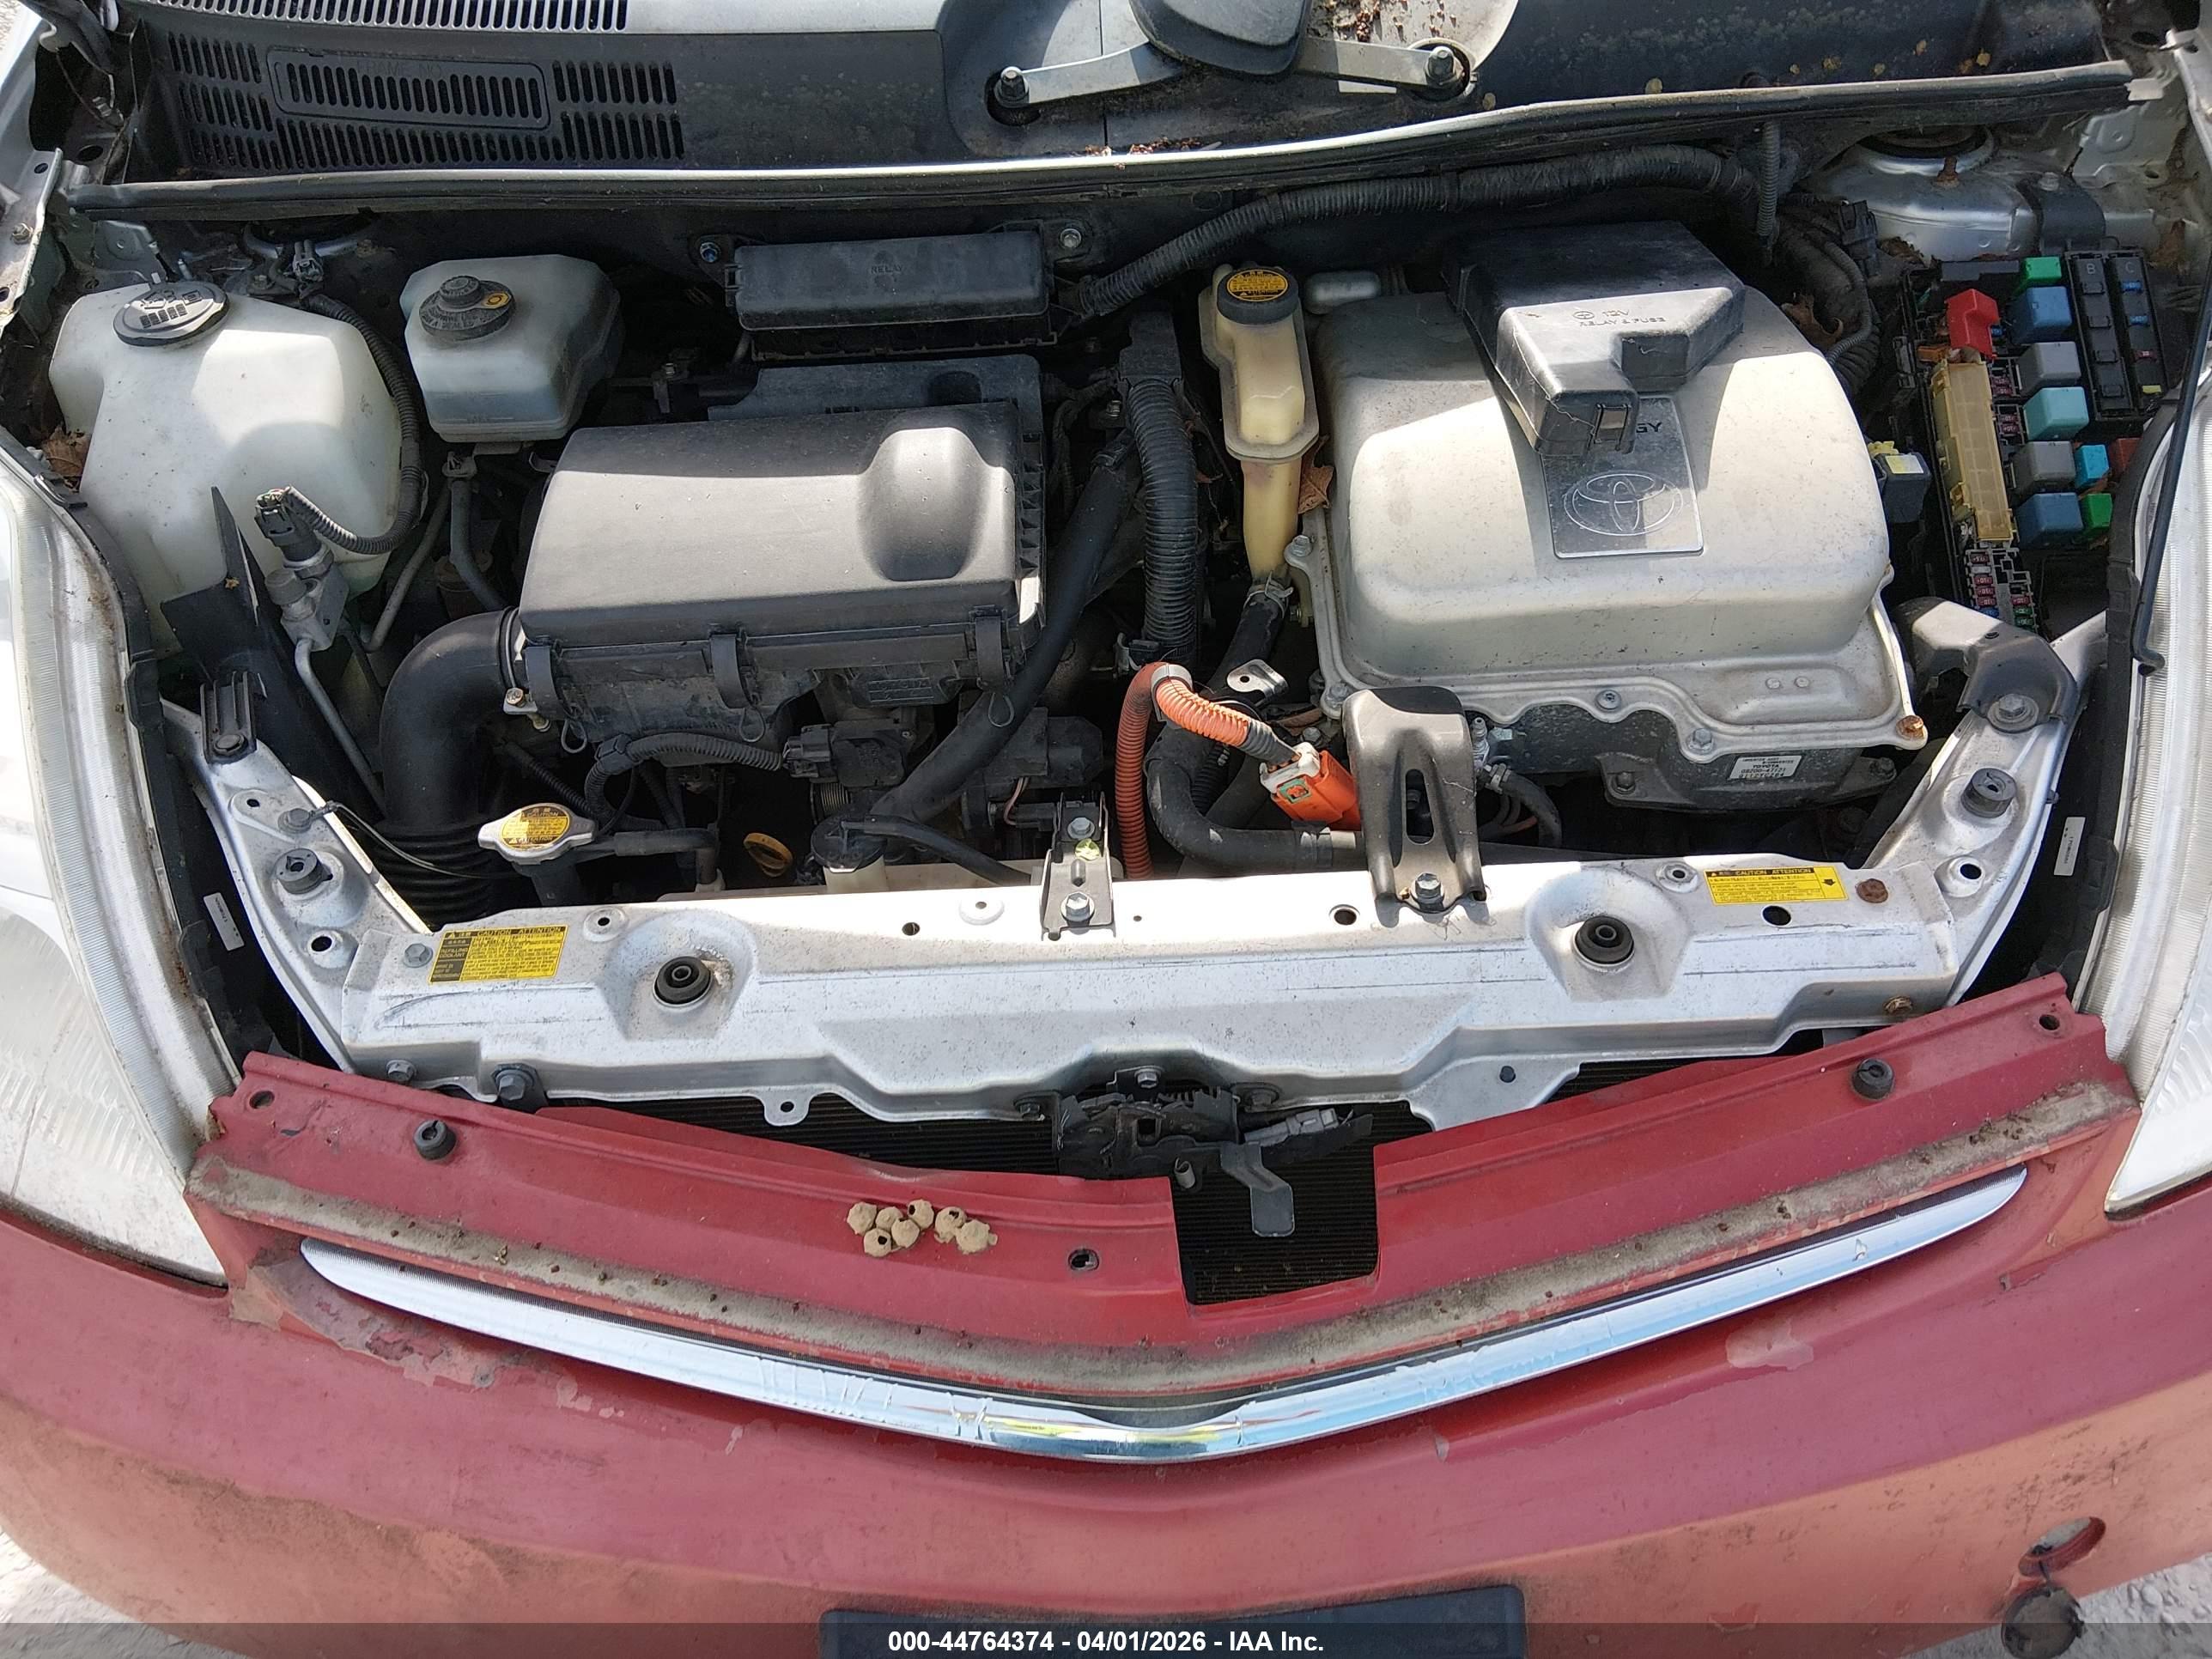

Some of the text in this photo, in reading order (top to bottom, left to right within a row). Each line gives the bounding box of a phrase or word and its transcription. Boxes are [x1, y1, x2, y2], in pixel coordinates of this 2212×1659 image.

[870, 263, 904, 275] RELAY
[2086, 263, 2097, 275] B
[2124, 261, 2135, 273] C
[1579, 319, 1618, 327] RELAY
[1636, 422, 1662, 434] GY
